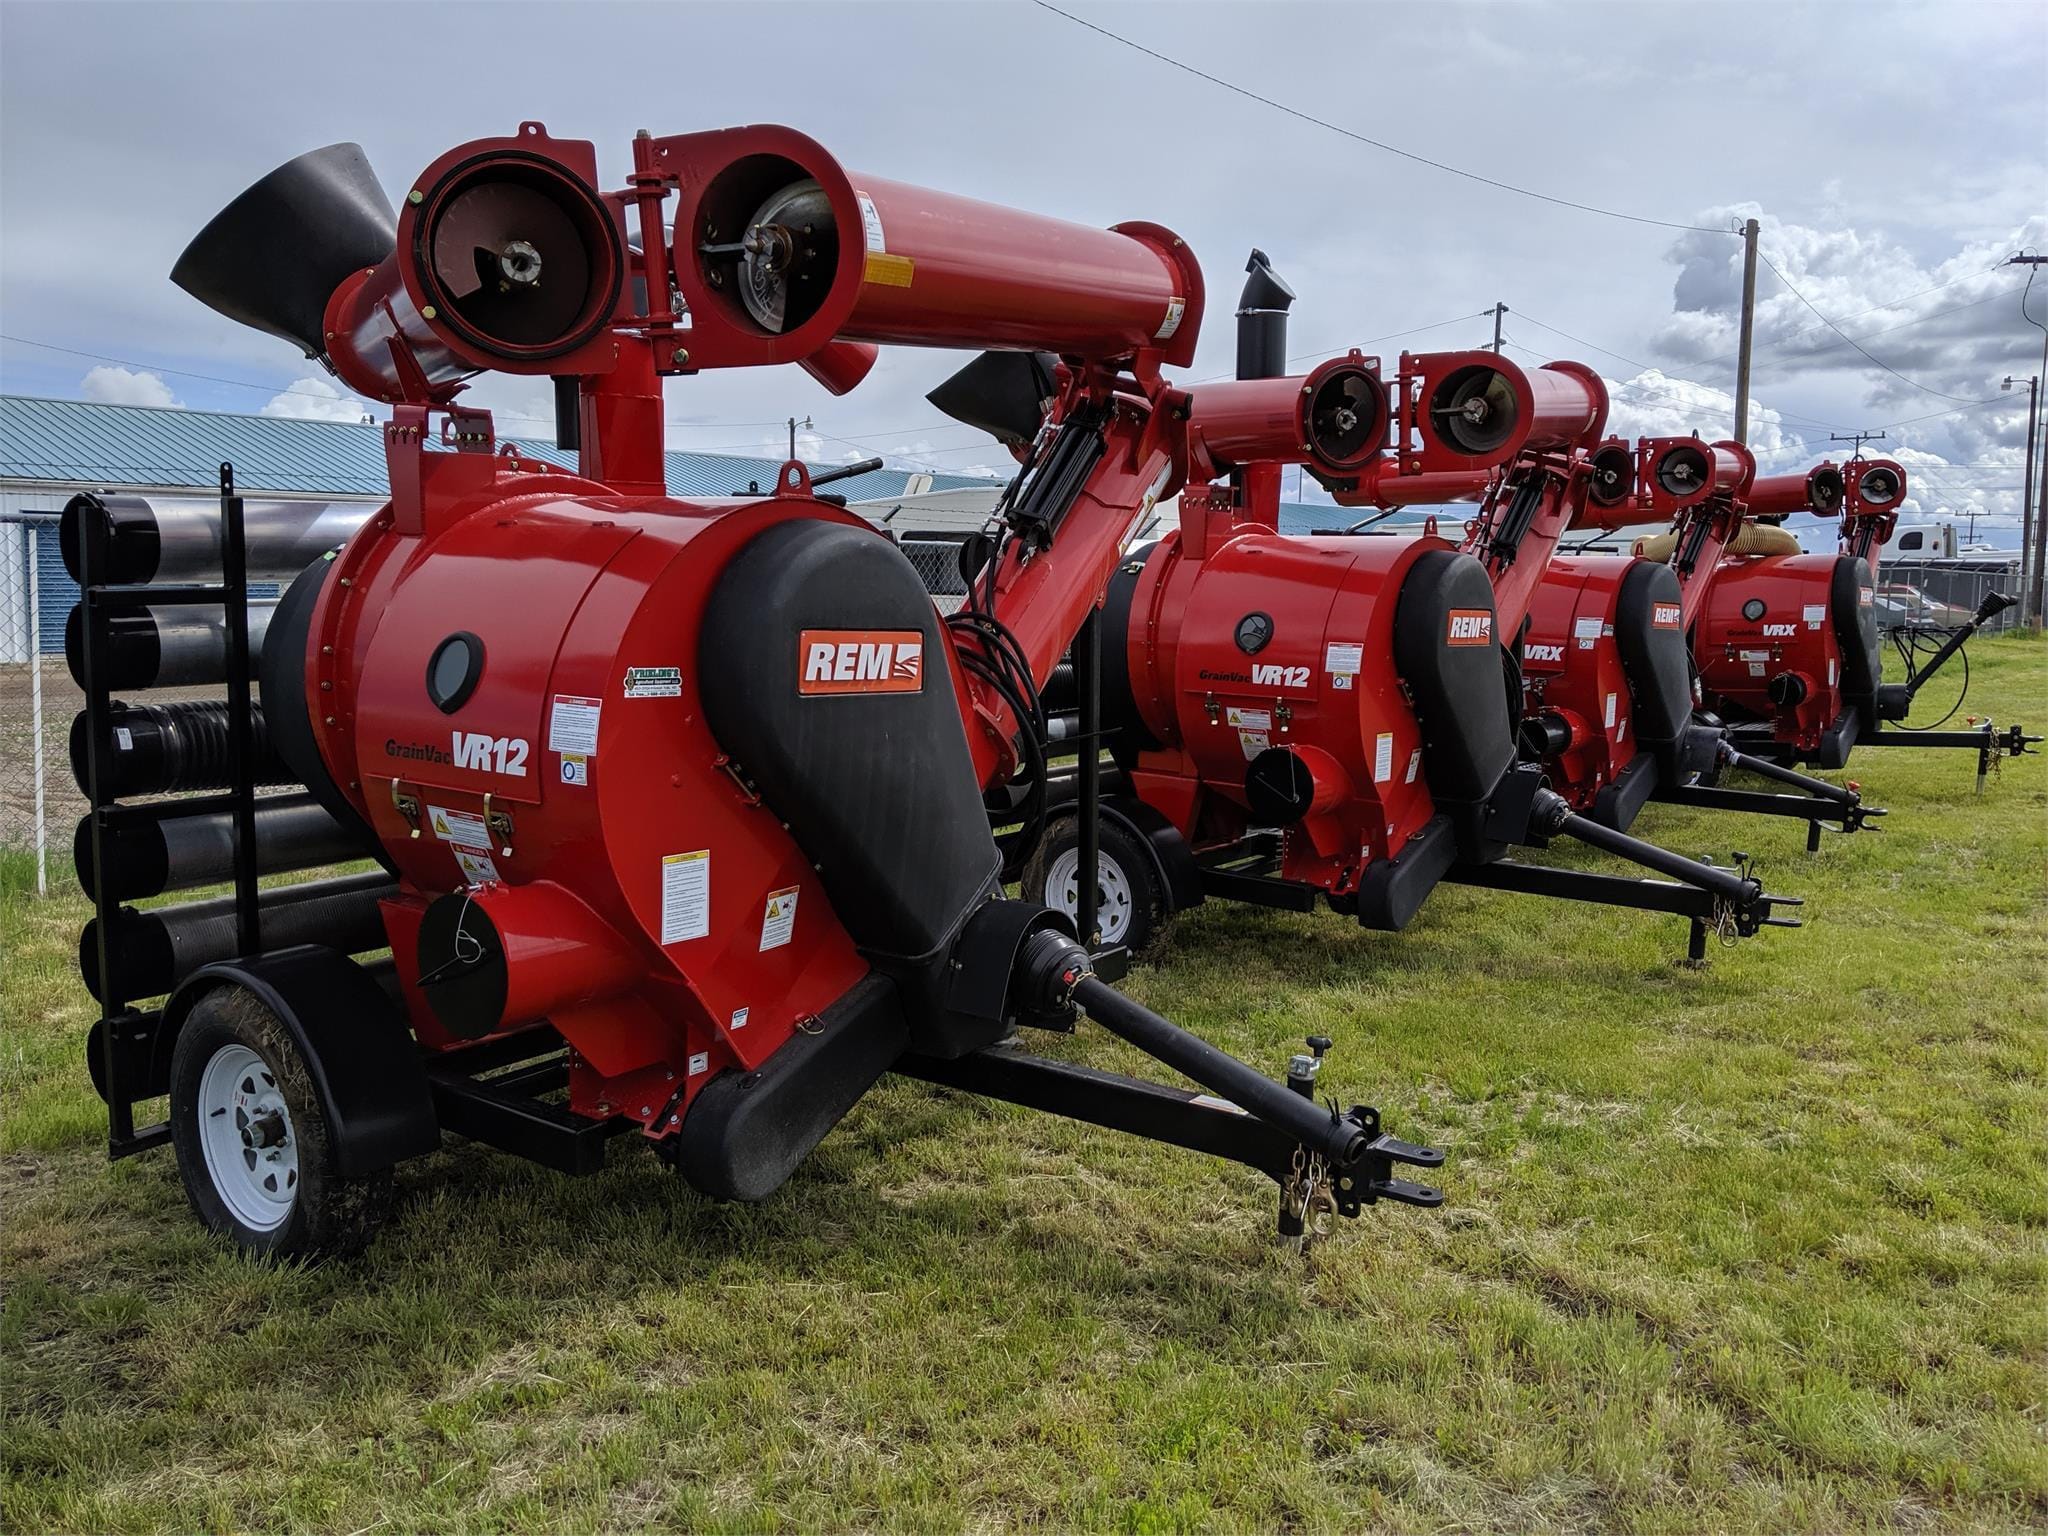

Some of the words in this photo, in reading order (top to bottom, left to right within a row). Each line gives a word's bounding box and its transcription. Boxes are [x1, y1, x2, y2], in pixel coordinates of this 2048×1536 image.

[1655, 607, 1673, 623] REM
[1450, 617, 1482, 638] REM
[1763, 624, 1797, 636] VRX
[805, 643, 893, 680] REM
[1524, 644, 1565, 661] VRX
[1200, 669, 1252, 684] GrainVac
[1252, 664, 1311, 688] VR12
[385, 739, 450, 764] GrainVac
[452, 731, 530, 777] VR12
